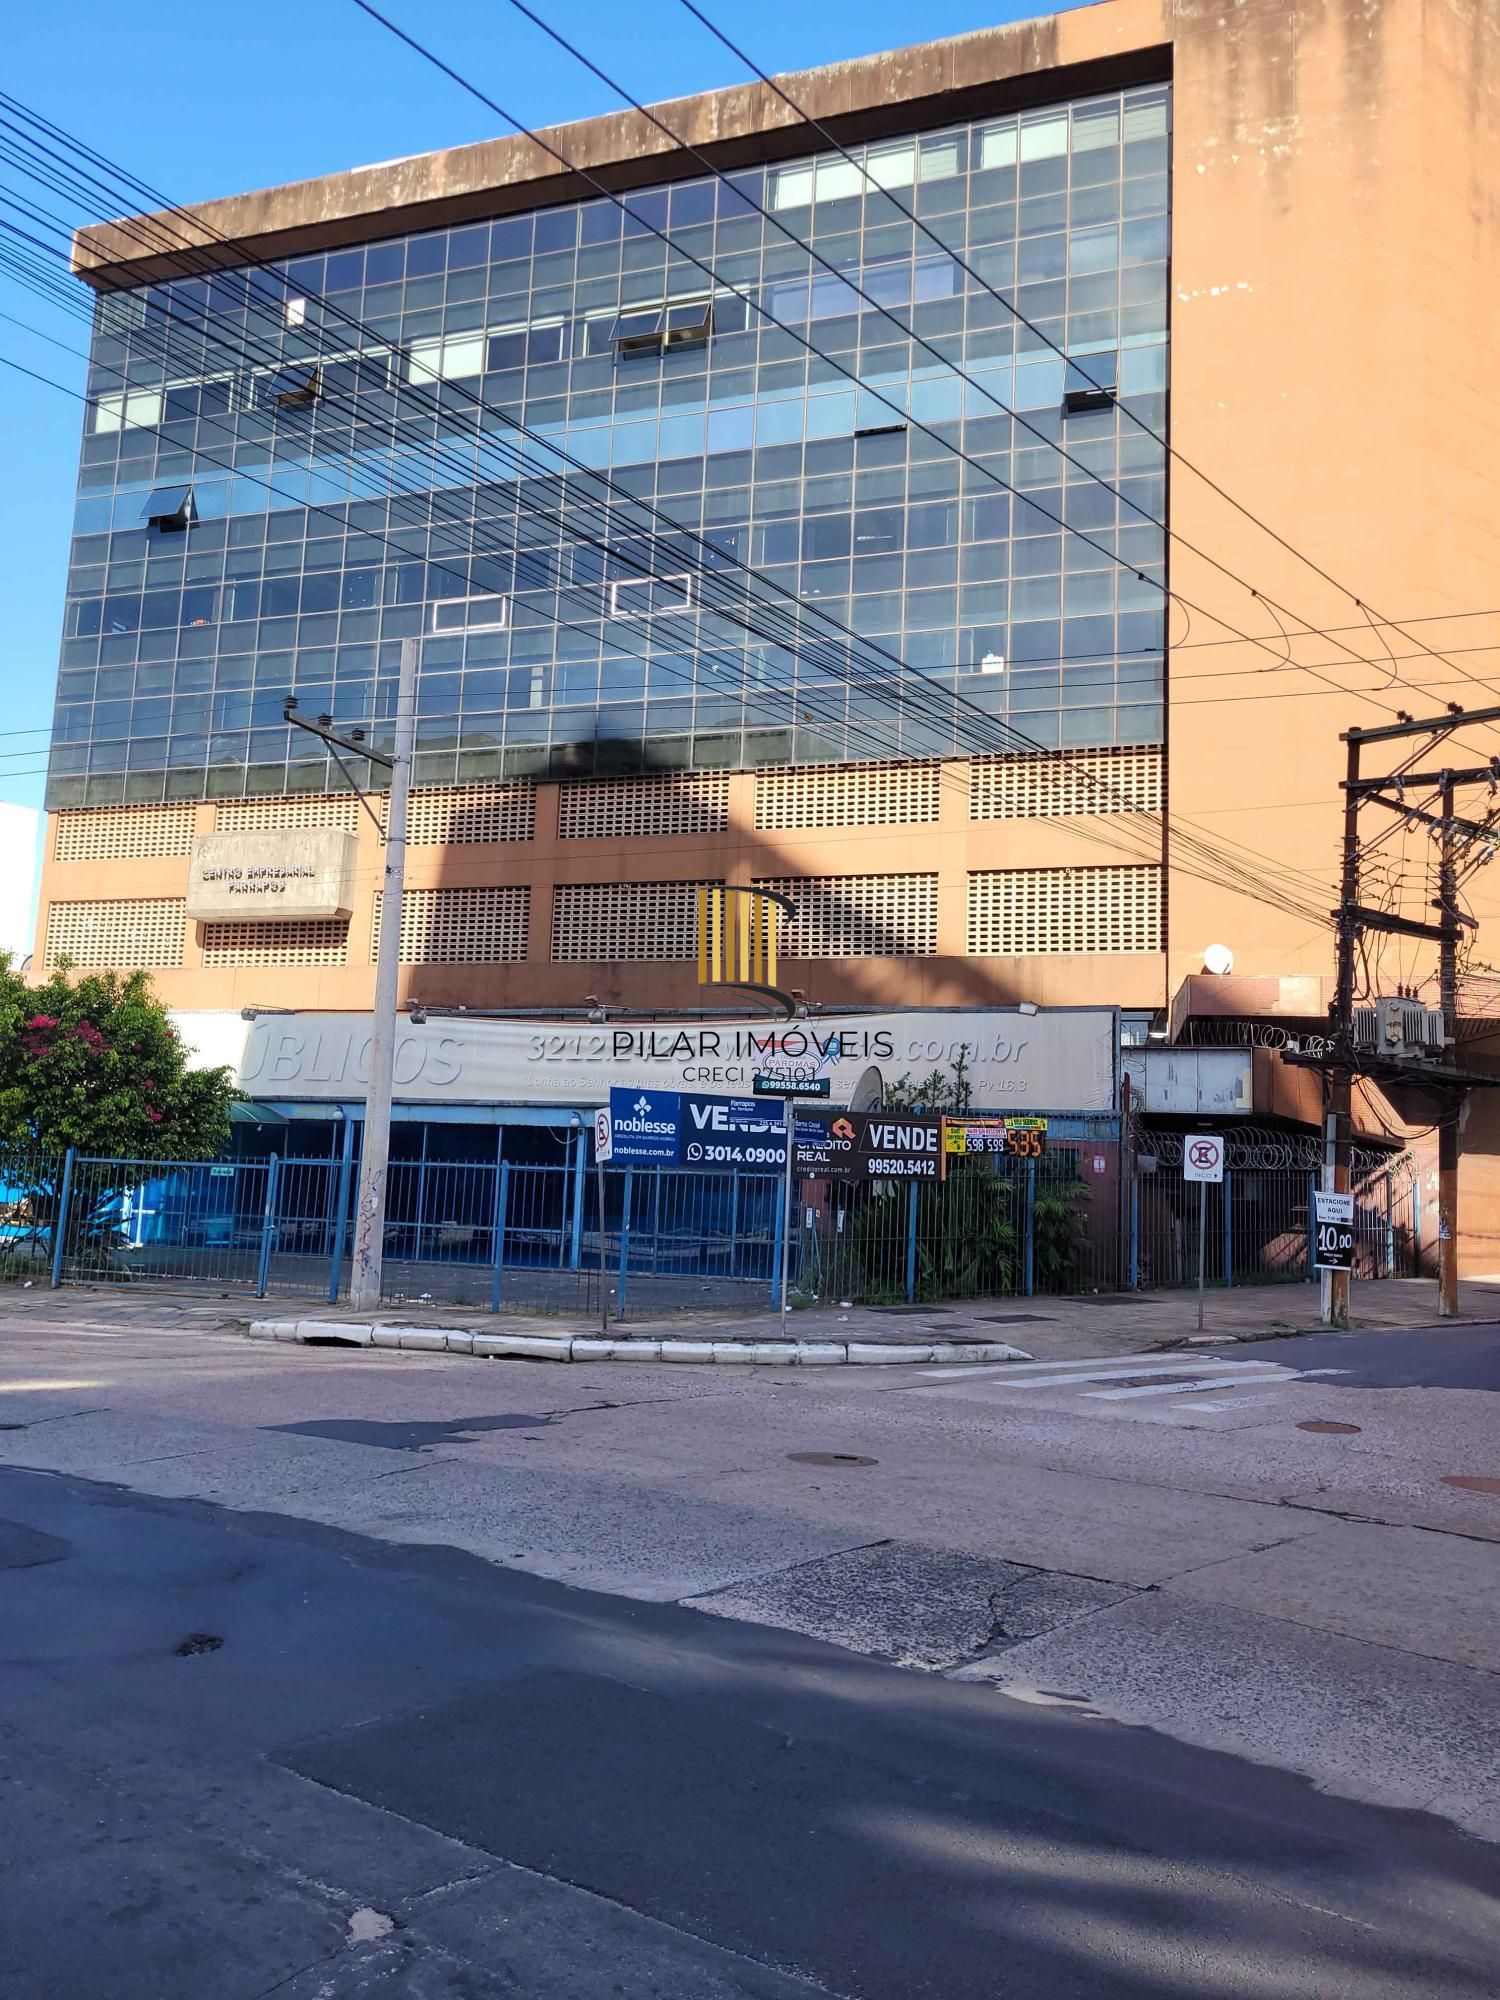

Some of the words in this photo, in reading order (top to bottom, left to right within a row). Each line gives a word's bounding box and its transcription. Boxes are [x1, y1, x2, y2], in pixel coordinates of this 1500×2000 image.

[202, 867, 243, 881] CENTRO
[247, 864, 315, 880] EMPRESARIAL
[228, 880, 286, 895] FARRAPOS
[769, 1080, 821, 1092] 99558.6540
[614, 1116, 676, 1134] noblesse
[797, 1139, 852, 1151] DITO
[868, 1123, 938, 1152] VENDE
[614, 1146, 675, 1157] noblesse.com.br
[704, 1145, 786, 1164] 3014.0900
[797, 1151, 831, 1162] REAL
[868, 1158, 935, 1175] 99520.5412
[1317, 1197, 1351, 1206] ESTACIONE
